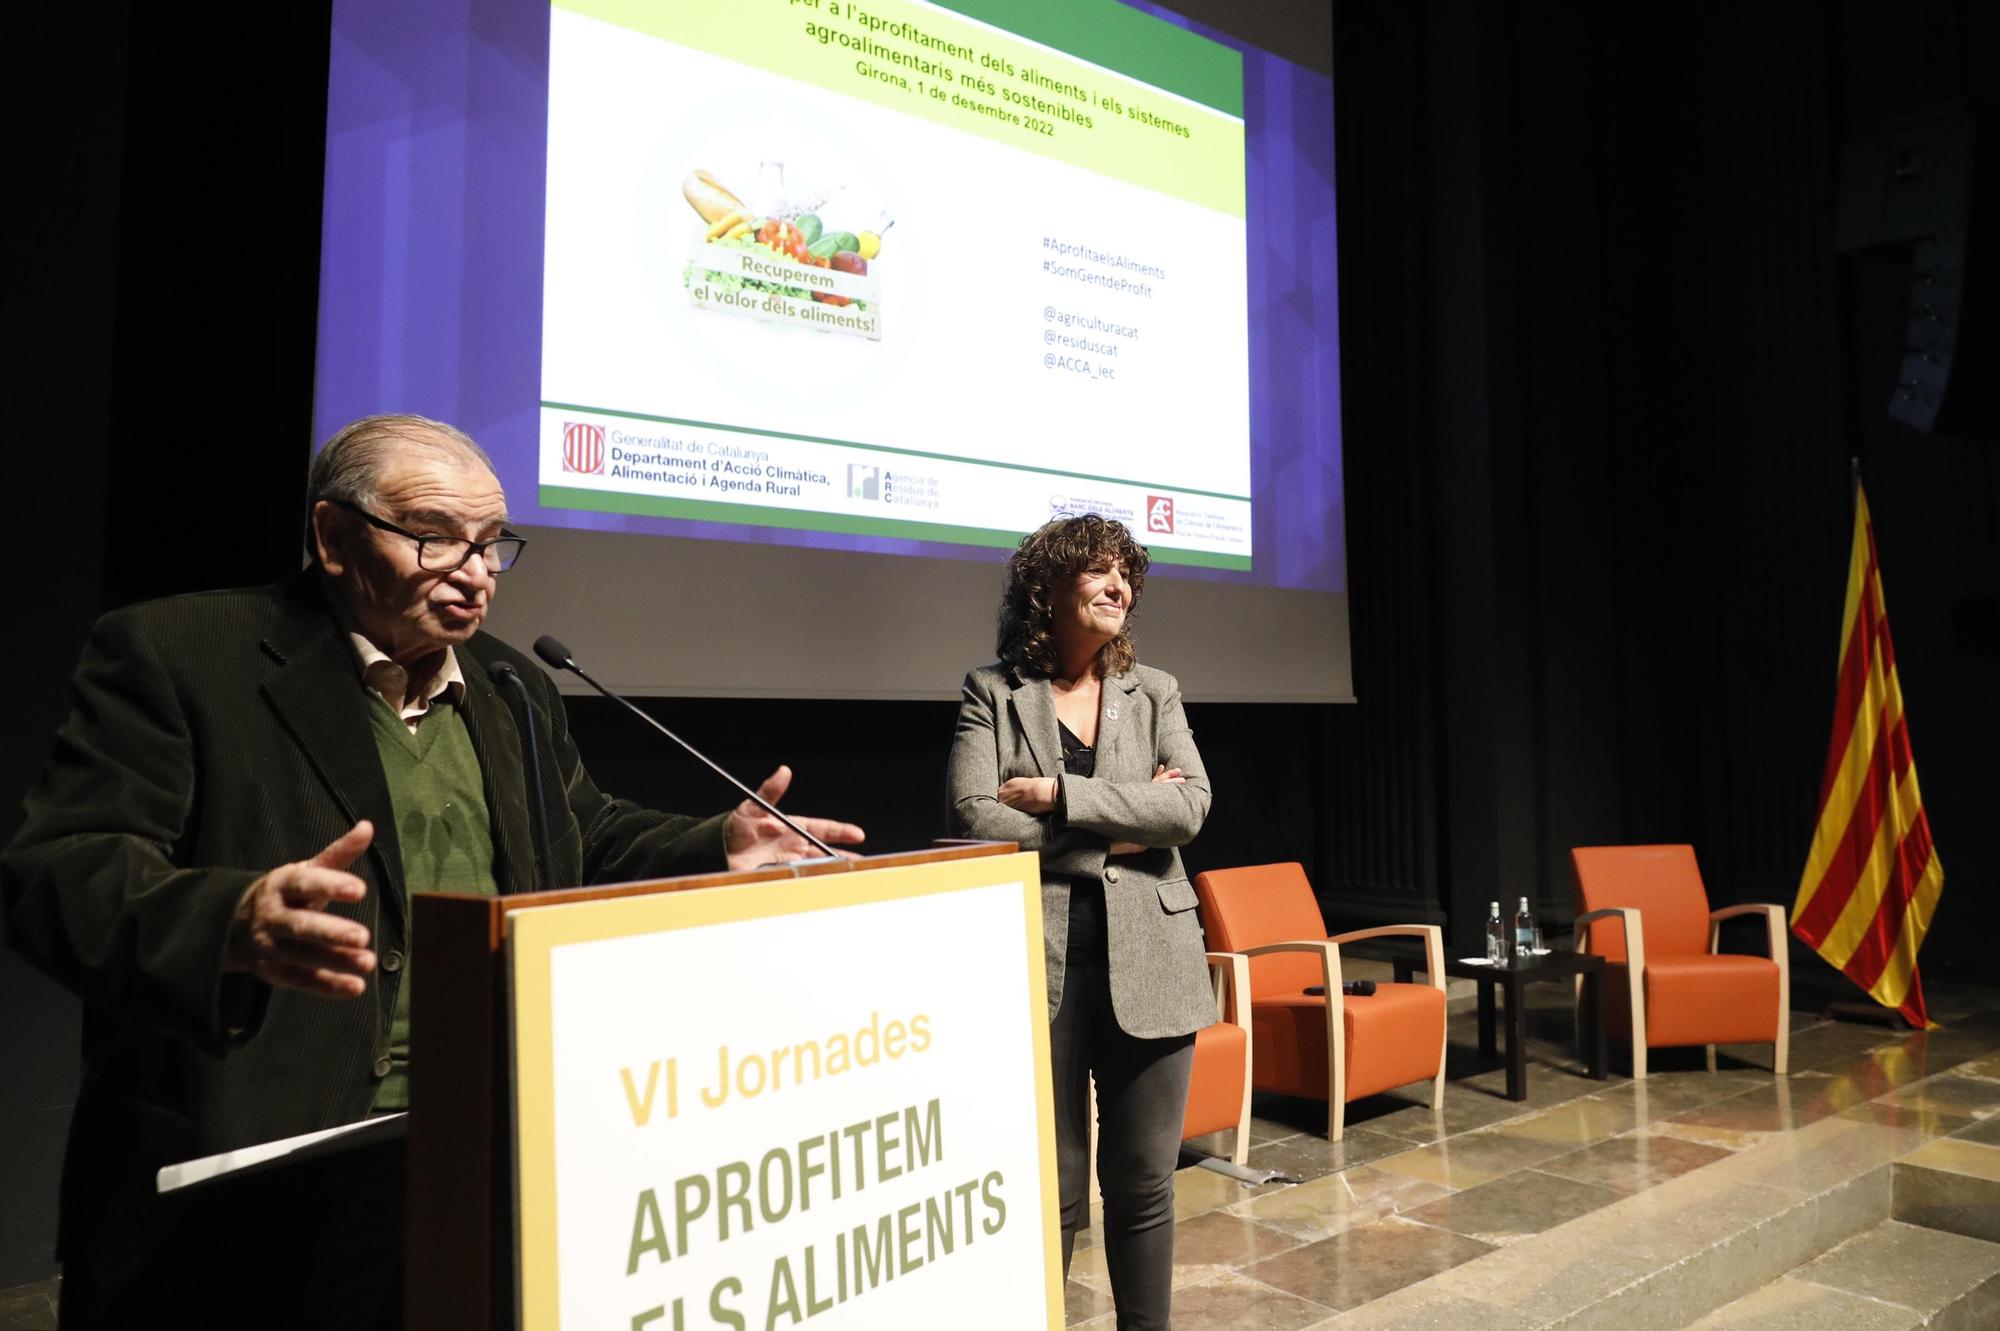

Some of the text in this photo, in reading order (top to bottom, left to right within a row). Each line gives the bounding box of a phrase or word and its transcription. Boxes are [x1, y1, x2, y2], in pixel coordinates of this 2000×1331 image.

[806, 21, 1093, 129] agroalimentaris més sostenibles
[829, 2, 839, 15] a
[847, 3, 974, 63] l'aprofitament
[980, 53, 1015, 77] dels
[1021, 68, 1086, 103] aliments
[1101, 97, 1123, 115] els
[1128, 105, 1190, 138] sistemes
[856, 61, 1054, 137] Girona, 1 de desembre 2022
[742, 255, 834, 288] Recuperem
[1043, 236, 1166, 280] #AprofitaelsAliments
[1043, 260, 1152, 298] #SomGentdeProfit
[694, 286, 875, 332] el valor dels aliments!
[1044, 305, 1139, 339] @agriculturacat
[1044, 329, 1118, 357] @residuscat
[1044, 353, 1115, 379] @ACCA_iec
[611, 430, 768, 464] Generalitat de Catalunya
[611, 448, 830, 486] Departament d'Acció Climàtica,
[611, 465, 697, 486] Alimentació
[710, 476, 761, 492] Agenda
[766, 481, 800, 497] Rural
[619, 1012, 932, 1128] VI Jornades
[625, 1097, 943, 1276] APROFITEM
[765, 1170, 1007, 1331] ALIMENTS
